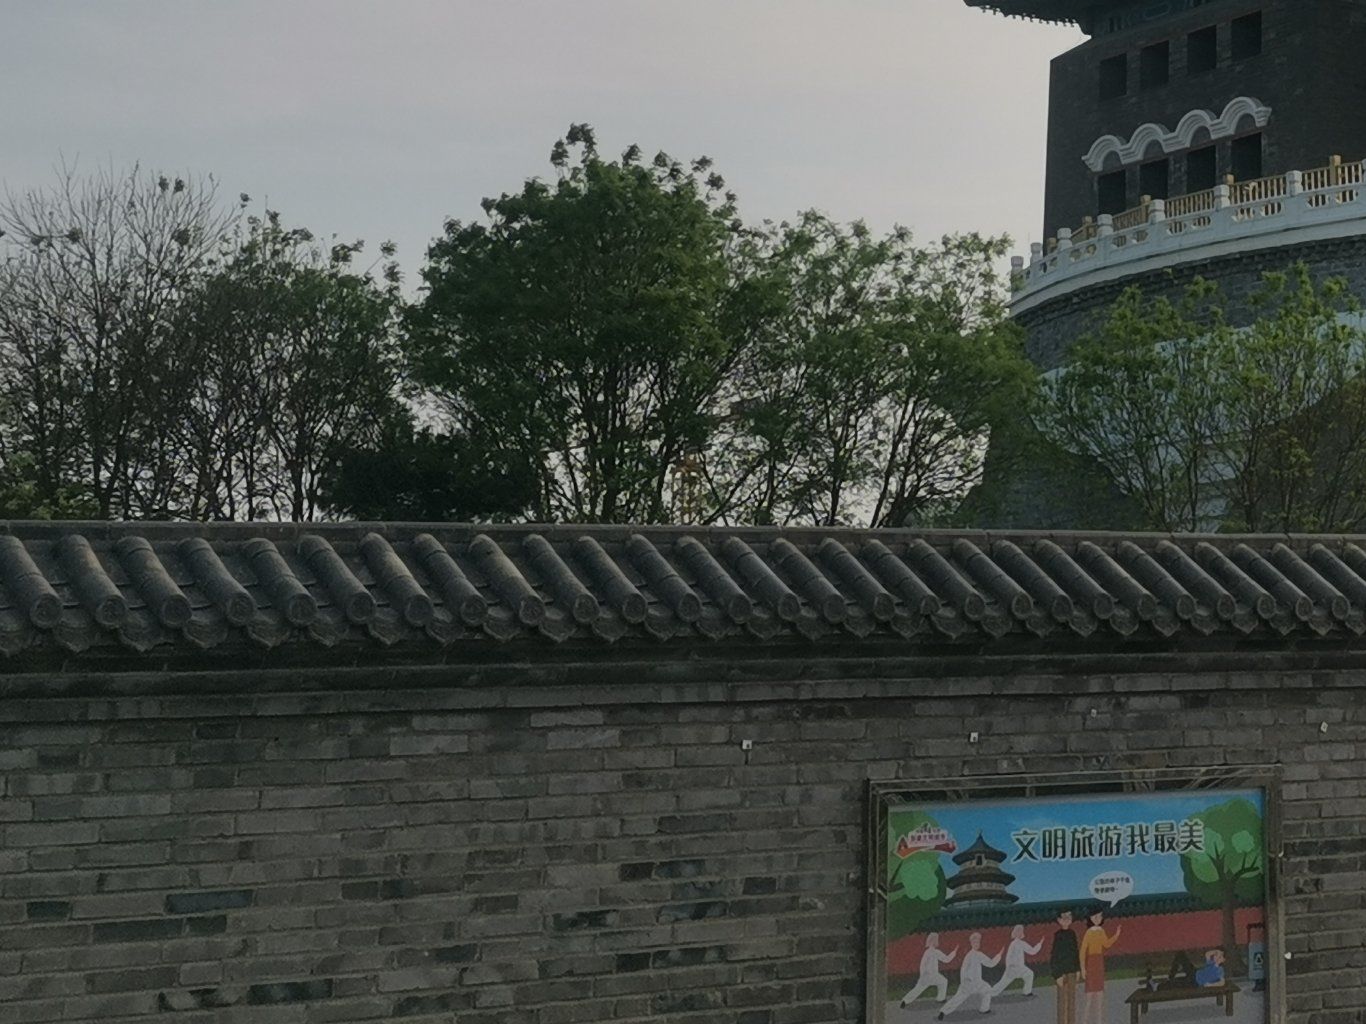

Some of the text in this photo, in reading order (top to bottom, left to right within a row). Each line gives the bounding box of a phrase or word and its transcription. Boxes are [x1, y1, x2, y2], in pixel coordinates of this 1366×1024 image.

[1012, 820, 1205, 862] 文明旅游我最美
